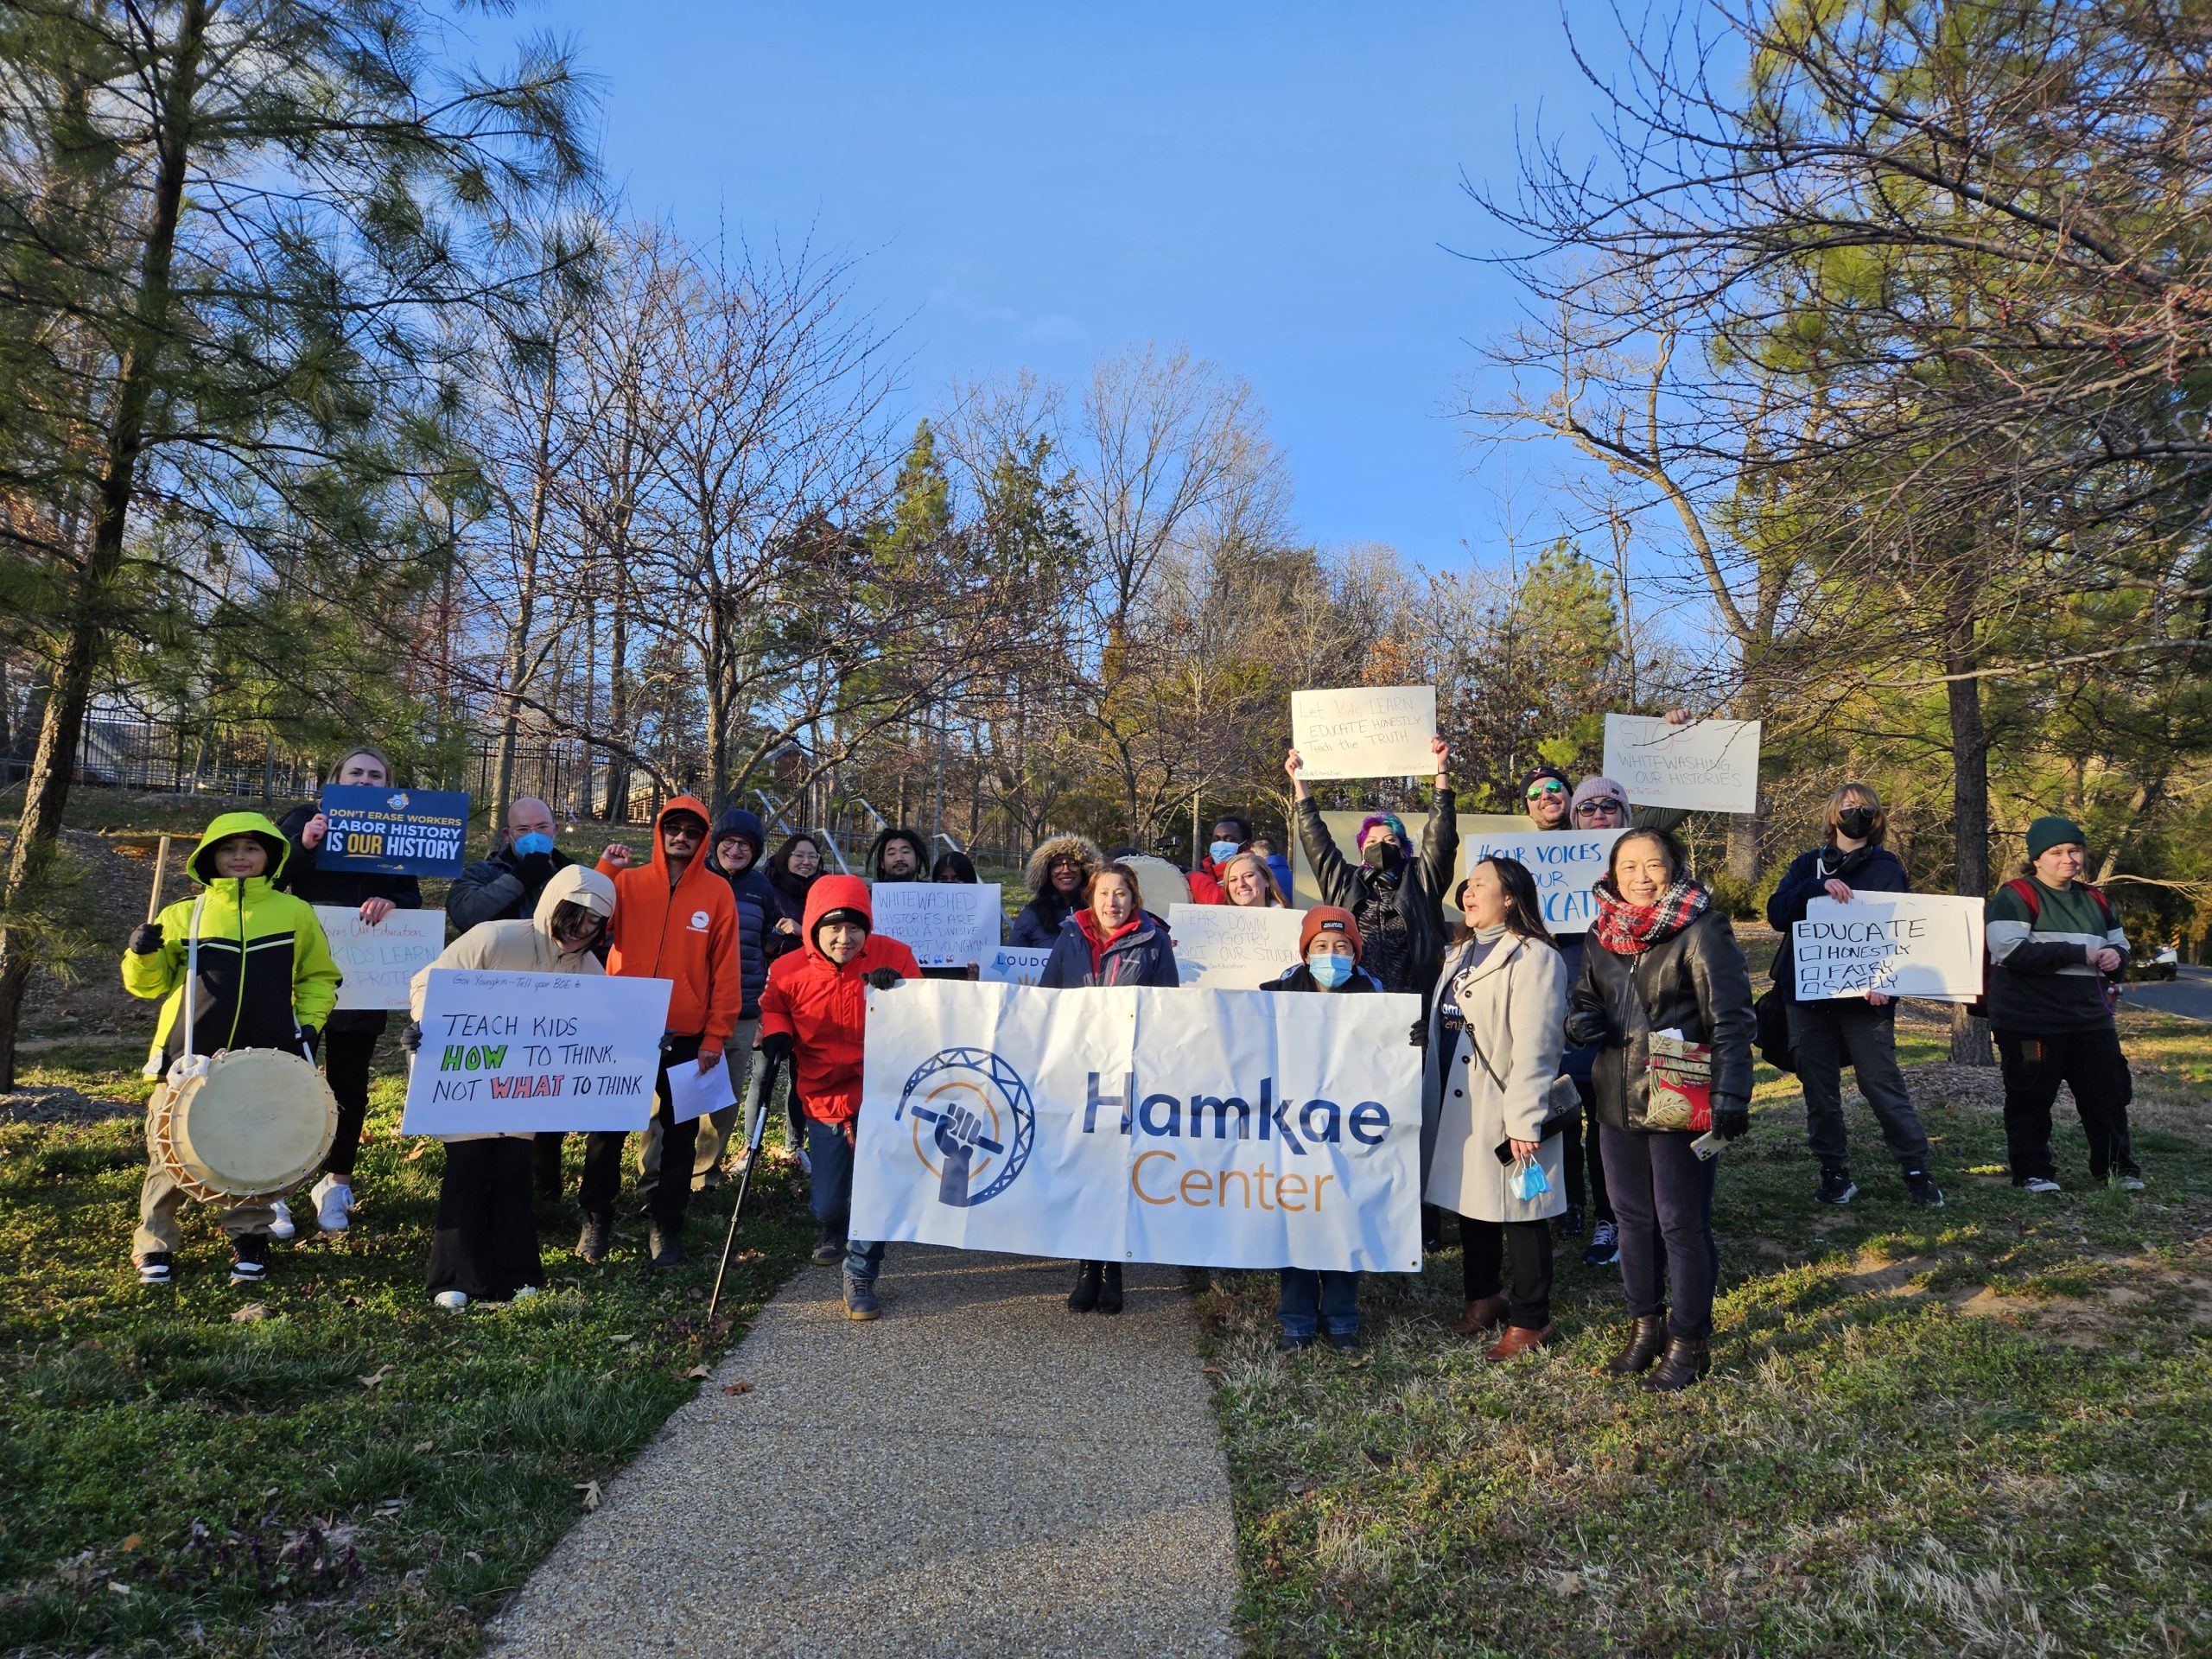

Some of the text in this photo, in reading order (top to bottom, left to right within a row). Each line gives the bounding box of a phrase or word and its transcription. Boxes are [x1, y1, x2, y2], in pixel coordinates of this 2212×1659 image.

[1299, 700, 1324, 719] Let
[1369, 696, 1414, 715] LEARN
[1309, 715, 1421, 738] EDUCATE HONESTLY
[1619, 720, 1696, 753] STOP
[1303, 729, 1409, 754] Teach the TRUTH
[1618, 752, 1731, 771] WHITEWASHING
[1635, 770, 1742, 787] OUR HISTORIES
[329, 809, 461, 826] DON'T ERASE WORKERS
[327, 819, 461, 840] LABOR HISTORY
[326, 831, 461, 861] IS OUR HISTORY
[1536, 842, 1602, 864] VOICES
[876, 890, 978, 912] WHITEWASHED
[880, 912, 976, 926] HISTORIES ARE
[1177, 910, 1268, 932] TEAR DOWN
[1797, 918, 1927, 942] EDUCATE
[923, 927, 931, 938] A
[1205, 930, 1270, 947] BIGOTRY
[331, 944, 435, 965] KIDS LEARN
[1179, 945, 1207, 958] NOT
[1219, 946, 1253, 961] OUR
[1828, 944, 1911, 959] HONESTLY
[1828, 959, 1894, 980] FAIRLY
[534, 982, 550, 992] your
[553, 978, 572, 988] BOE
[1823, 975, 1897, 995] SAFELY
[442, 1014, 579, 1037] TEACH KIDS
[441, 1044, 508, 1071] HOW
[523, 1045, 551, 1066] TO
[432, 1075, 643, 1104] NOT WHAT TO THINK
[1082, 1071, 1391, 1156] Hamkae
[1132, 1149, 1334, 1212] Center
